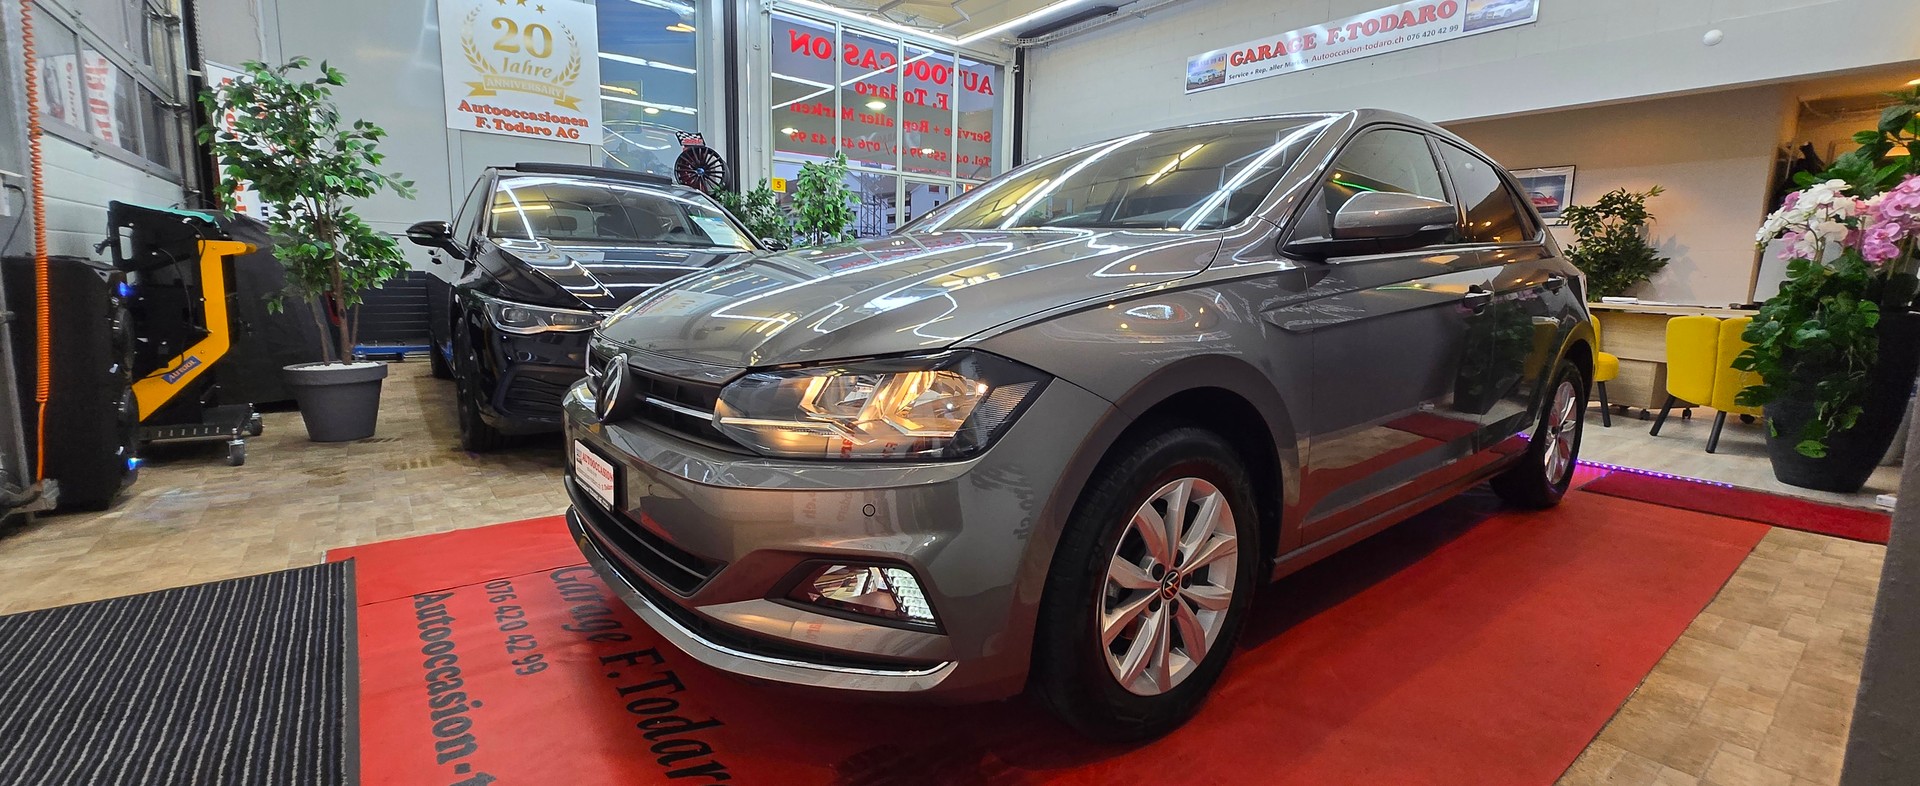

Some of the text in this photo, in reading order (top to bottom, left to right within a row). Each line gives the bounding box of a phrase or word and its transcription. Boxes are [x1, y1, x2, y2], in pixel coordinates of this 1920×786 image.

[491, 17, 553, 59] 20
[1406, 32, 1420, 42] 076
[1421, 29, 1436, 39] 420
[1437, 27, 1447, 35] 42
[1449, 24, 1459, 33] 99
[1230, 33, 1317, 67] GARAGE
[502, 57, 552, 78] Jahre
[486, 77, 562, 98] ANNIVERSARY
[457, 99, 589, 128] Autooccasionen
[475, 116, 580, 139] F. Todaro AG
[776, 180, 781, 189] 5
[484, 580, 549, 676] 076 420 42 99
[549, 566, 732, 786] Garage F.Todar
